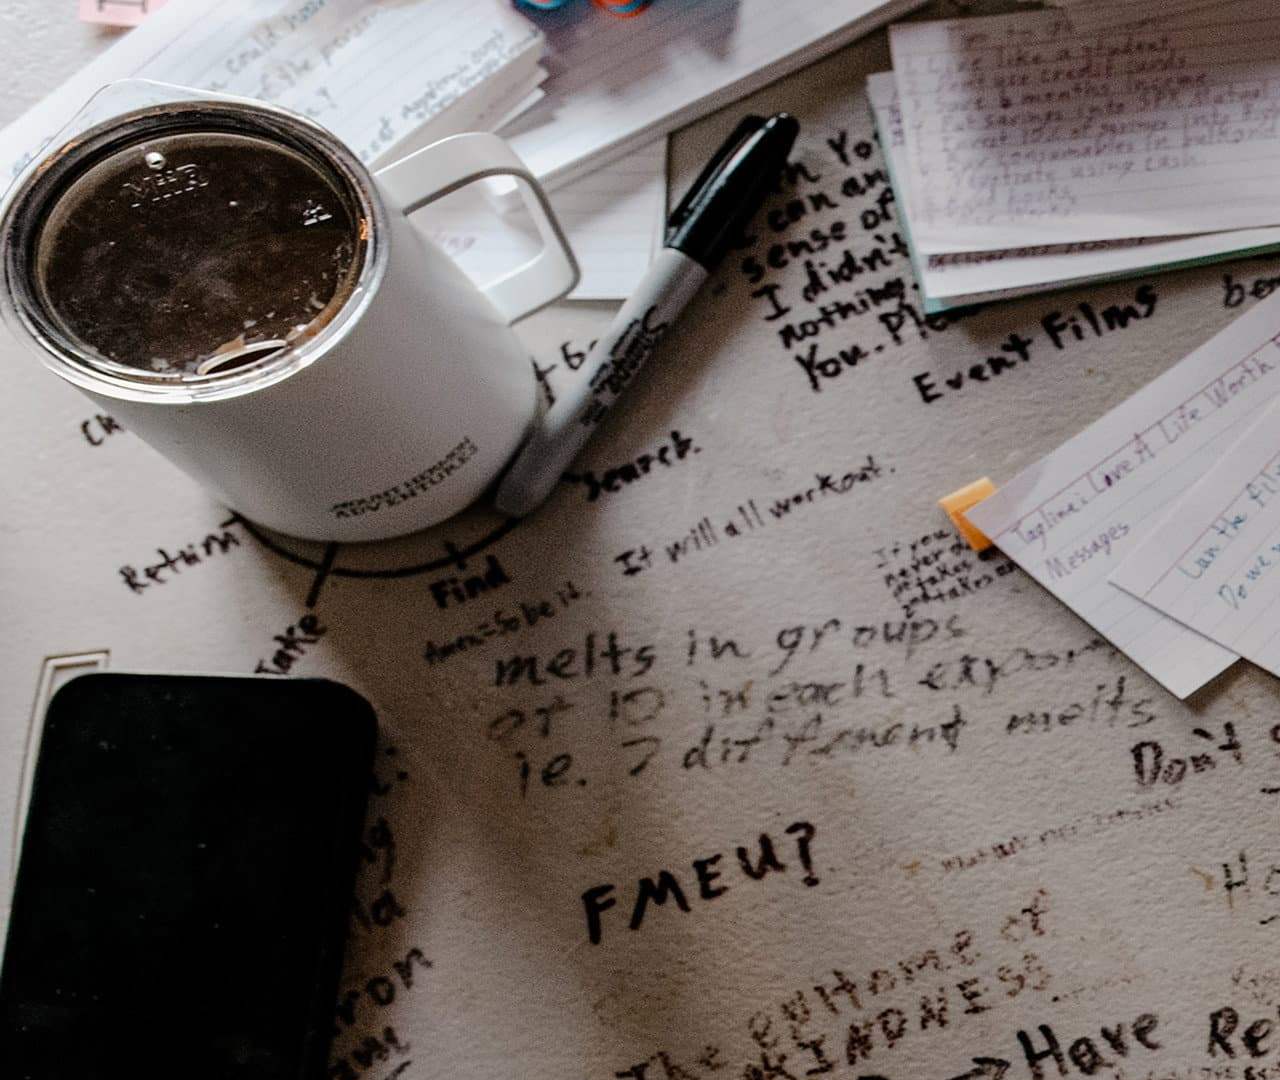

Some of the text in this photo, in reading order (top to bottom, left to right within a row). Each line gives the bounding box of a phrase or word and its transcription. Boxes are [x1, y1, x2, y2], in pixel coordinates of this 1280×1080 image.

[742, 221, 847, 284] sense
[751, 285, 791, 321] I
[796, 332, 885, 392] You.
[911, 284, 1159, 403] Event Films
[1203, 360, 1275, 408] Worth
[612, 498, 763, 578] It will all
[1045, 517, 1132, 582] Messages
[427, 553, 512, 611] Find
[256, 611, 329, 675] Take
[494, 613, 969, 690] melts in groups
[579, 819, 821, 946] FMEU?
[1000, 887, 1051, 944] of
